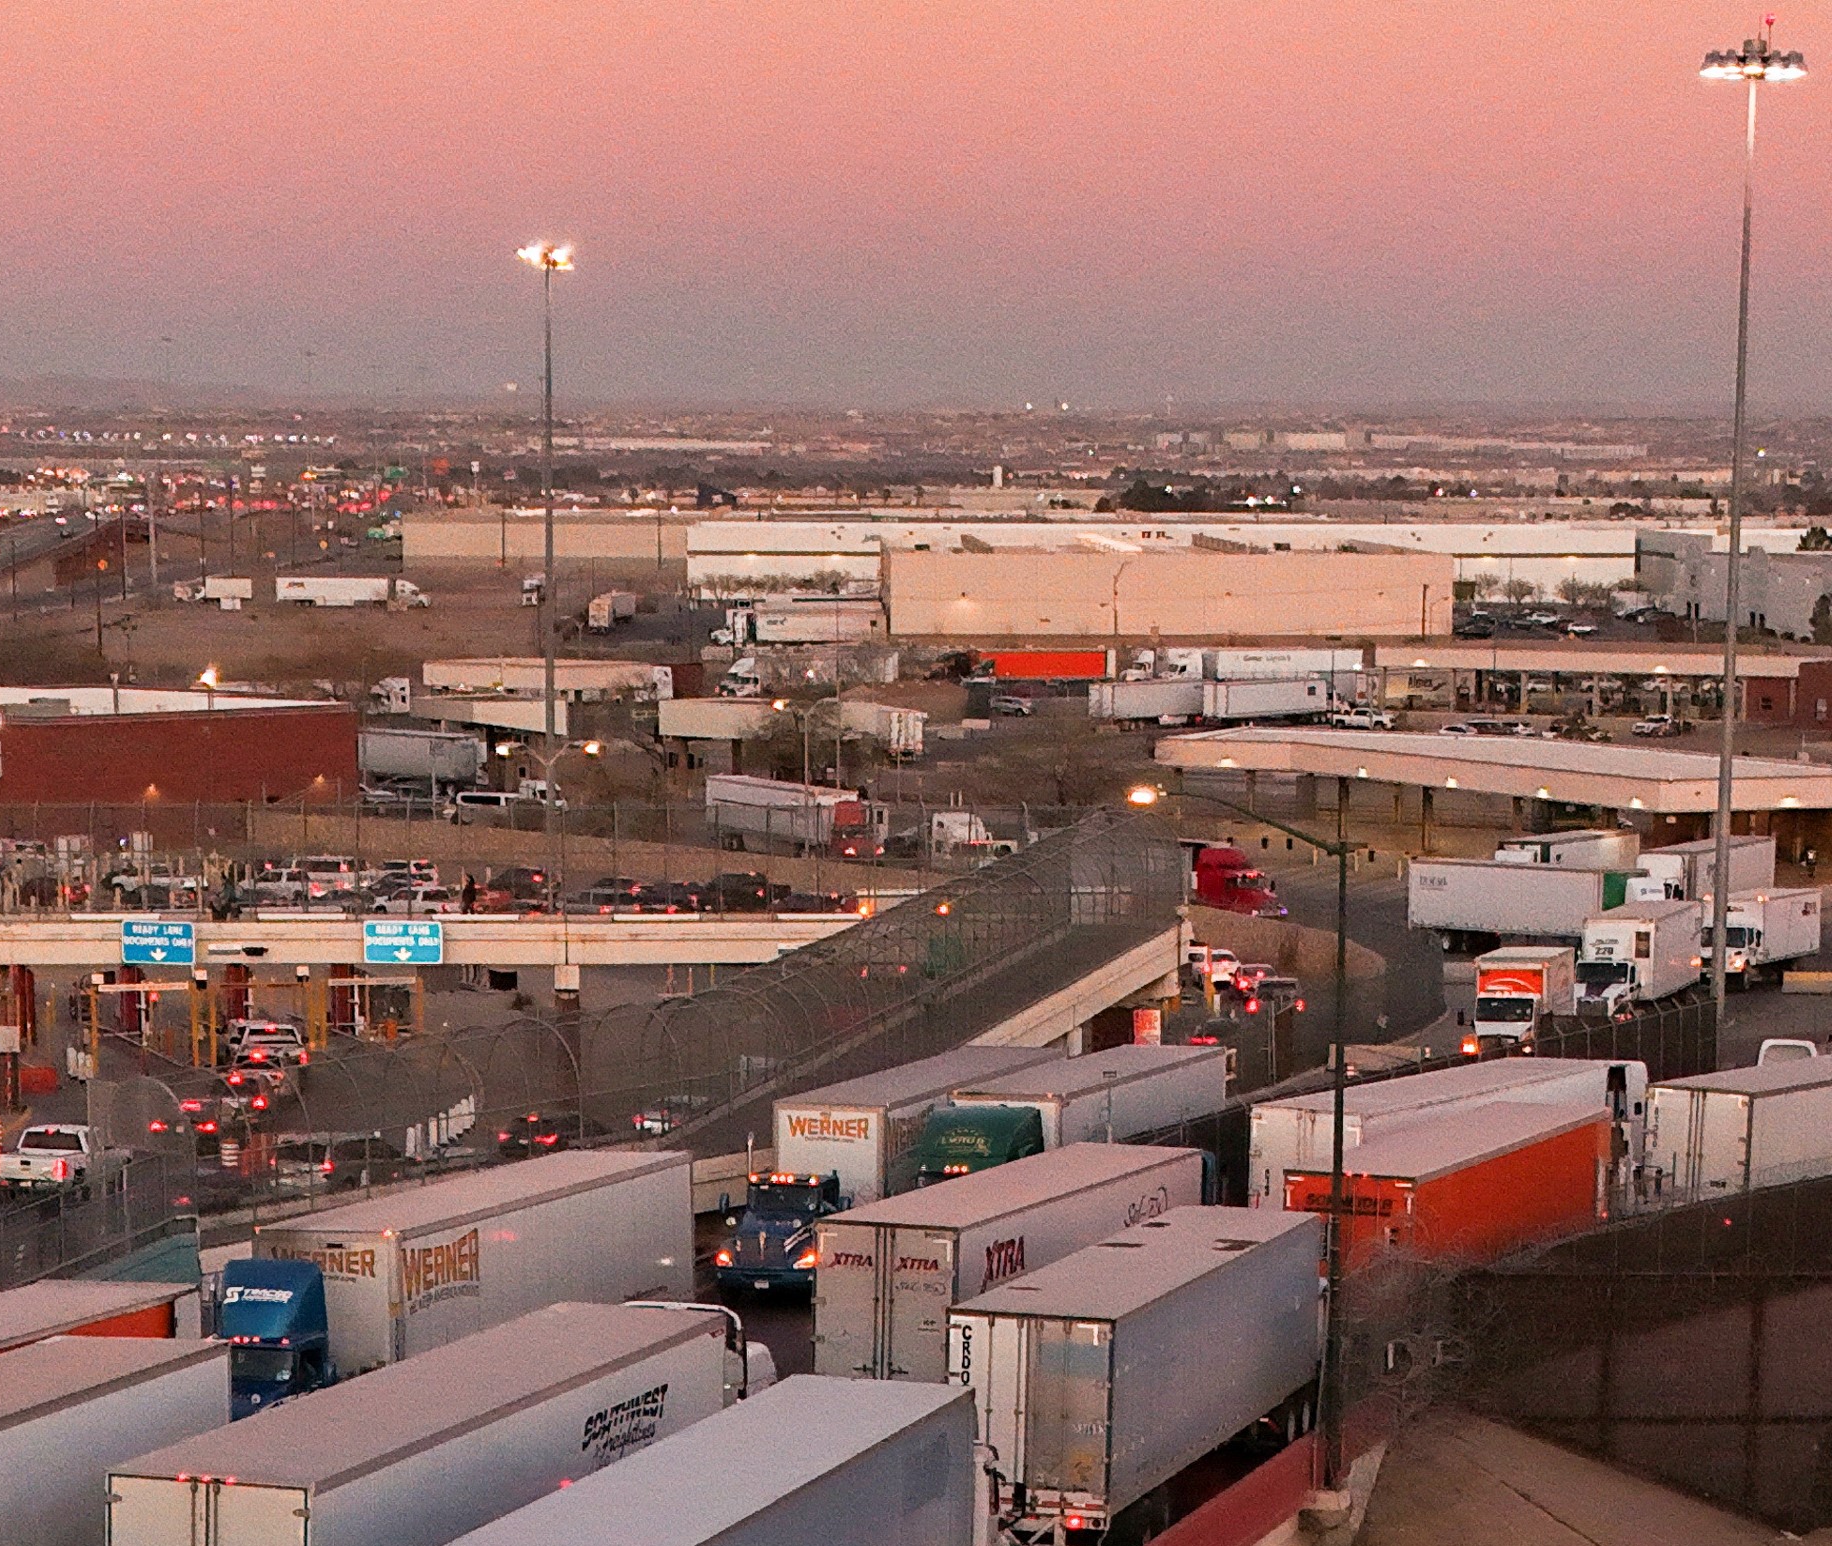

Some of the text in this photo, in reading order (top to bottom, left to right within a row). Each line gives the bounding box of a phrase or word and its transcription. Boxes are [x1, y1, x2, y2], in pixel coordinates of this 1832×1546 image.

[132, 924, 159, 935] READY
[375, 924, 404, 935] READY
[124, 936, 193, 948] DOCUMENTS ONLY
[365, 936, 439, 947] DOCUMENTS ONLY
[788, 1114, 869, 1140] WERNER
[402, 1227, 481, 1301] WERNER
[828, 1252, 873, 1268] XTRA
[891, 1256, 939, 1272] XTRA
[979, 1236, 1026, 1293] XTRA
[581, 1383, 668, 1452] SOUTHWEST
